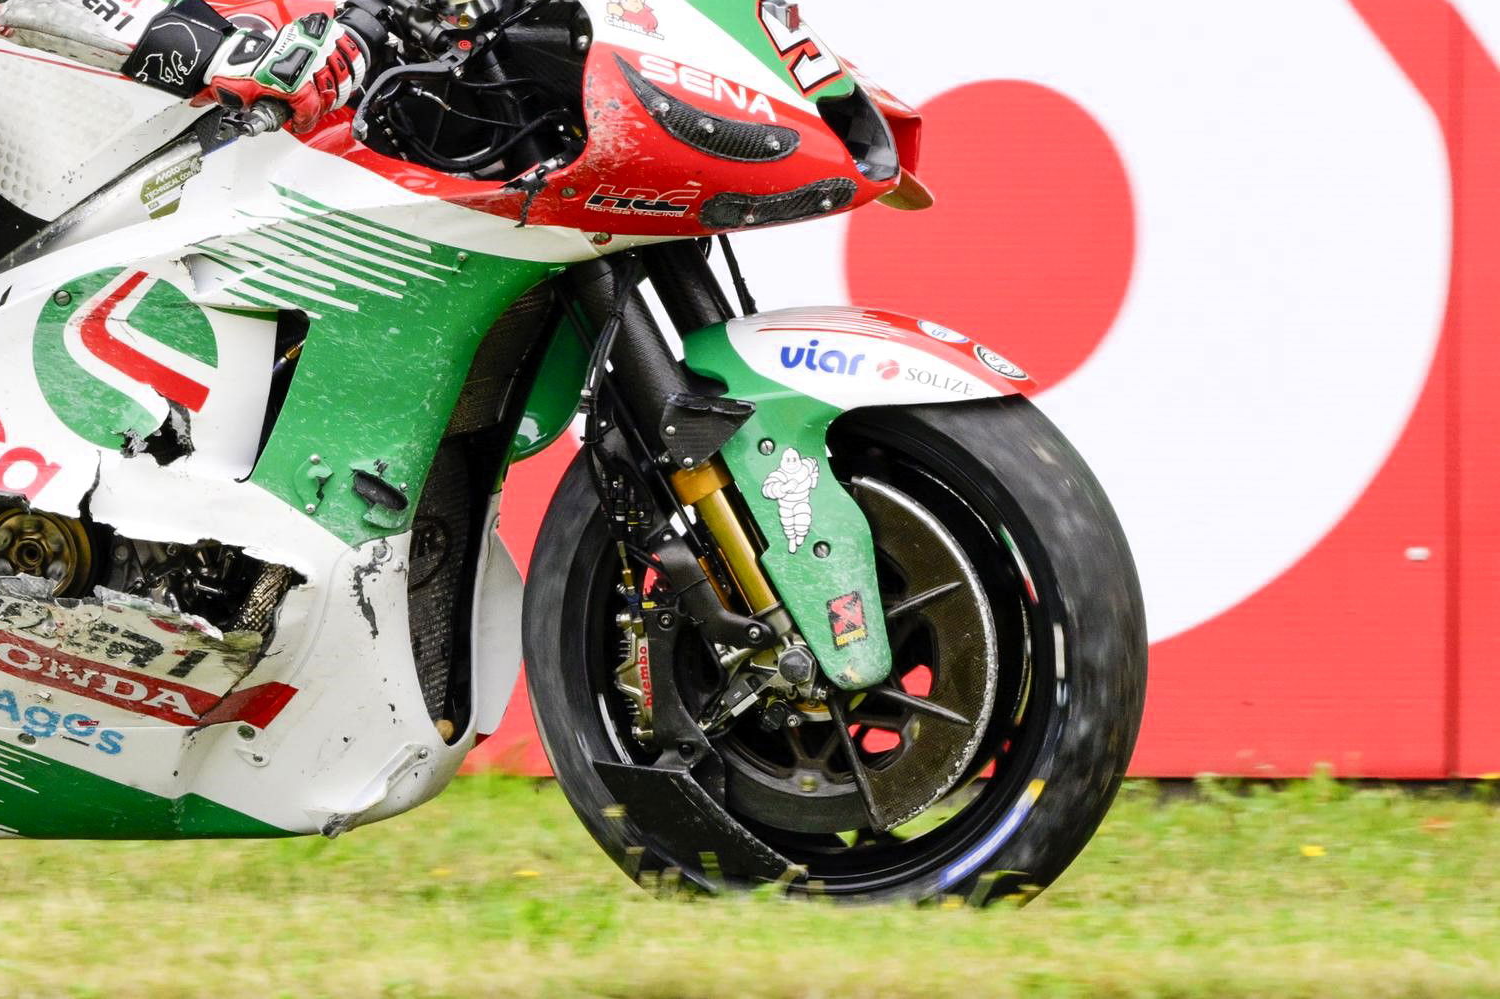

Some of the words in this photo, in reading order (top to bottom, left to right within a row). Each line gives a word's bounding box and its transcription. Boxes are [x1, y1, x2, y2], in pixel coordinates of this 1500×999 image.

[638, 54, 778, 123] SENA
[585, 183, 701, 213] HRC
[780, 339, 866, 376] viar
[904, 366, 974, 397] SOLIZE
[639, 646, 653, 709] brembo
